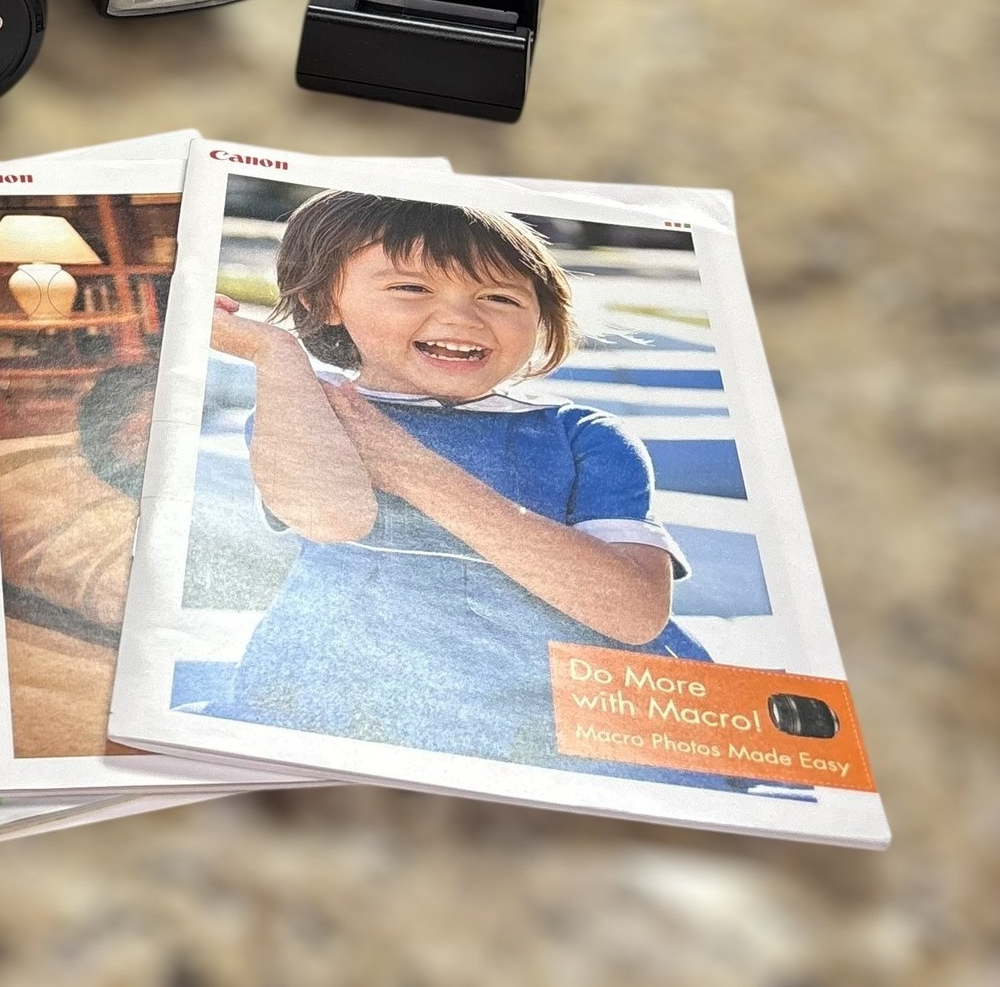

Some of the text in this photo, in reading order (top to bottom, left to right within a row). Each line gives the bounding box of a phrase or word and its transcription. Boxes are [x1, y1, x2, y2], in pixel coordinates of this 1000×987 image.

[208, 149, 289, 171] Canon
[568, 657, 707, 698] Do More
[570, 690, 762, 733] with Macro!
[575, 724, 851, 778] Macro Photos Made Easy
